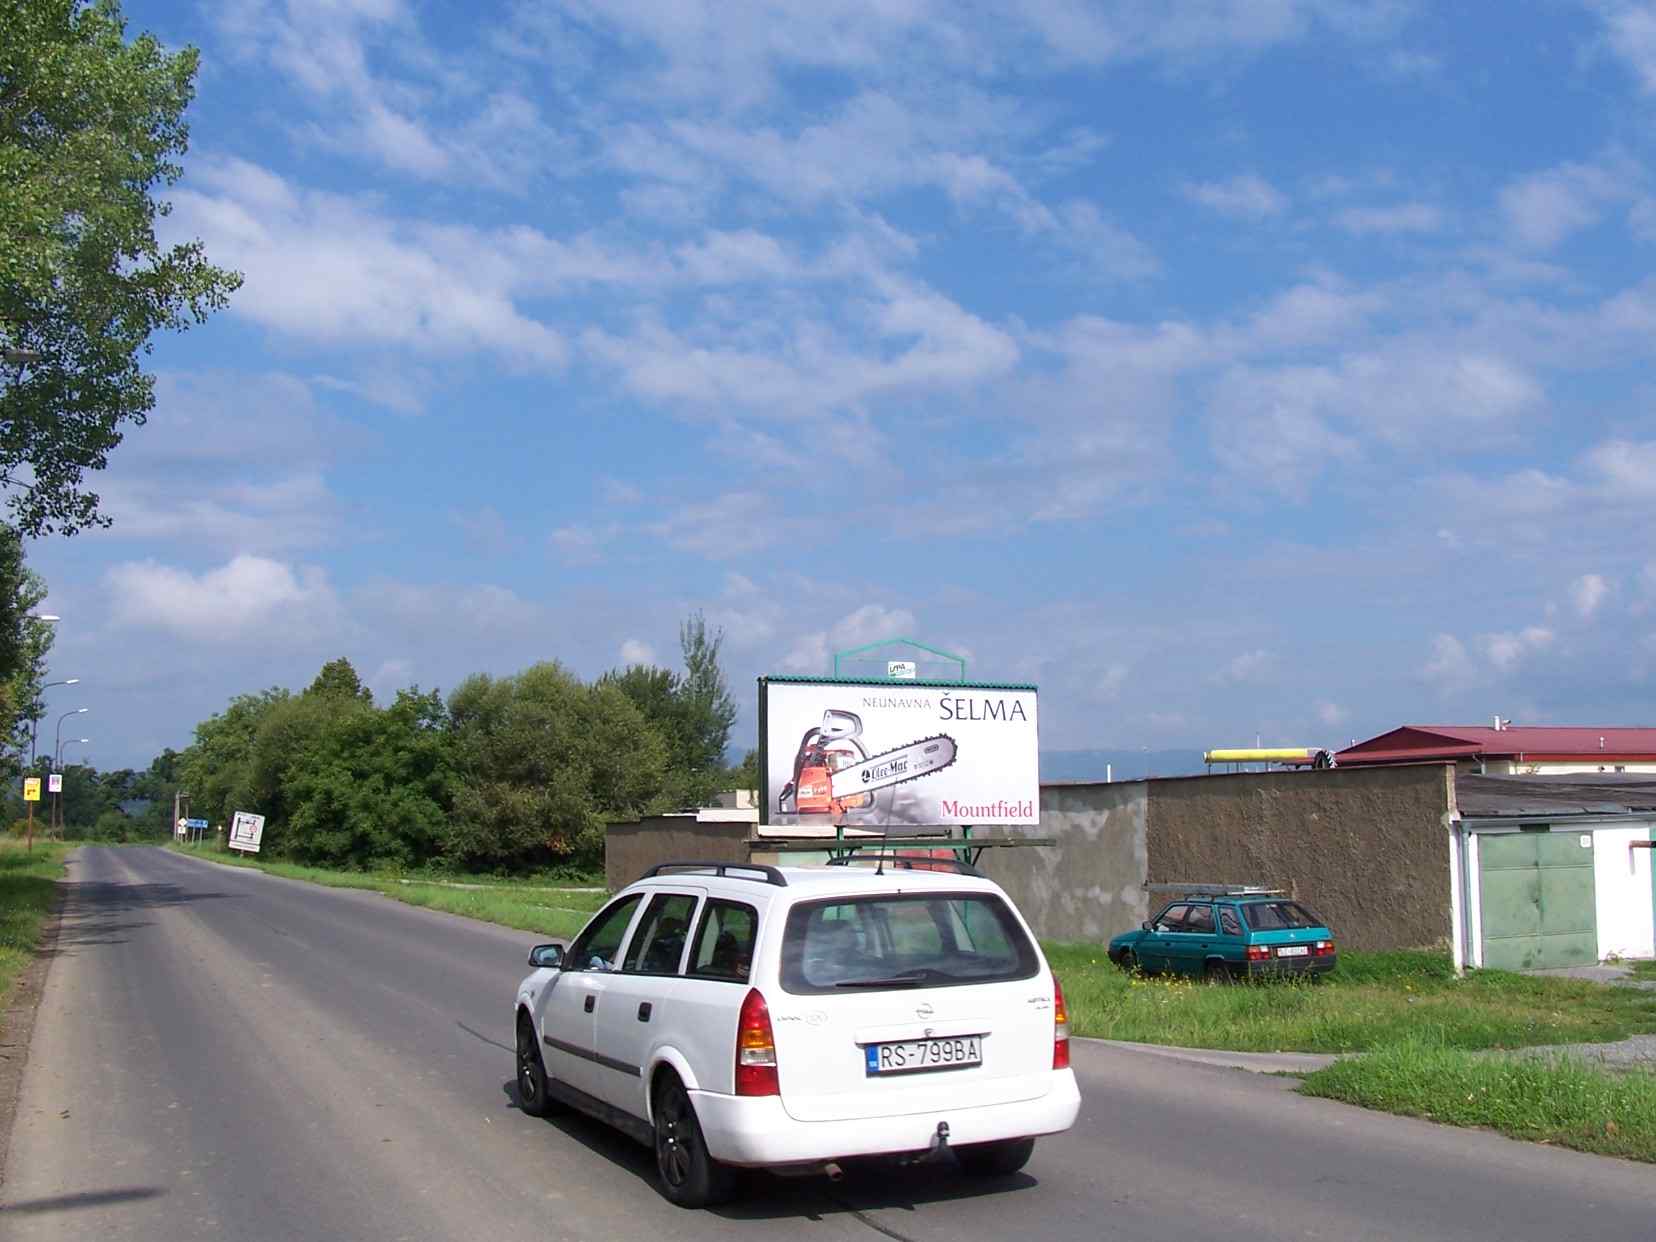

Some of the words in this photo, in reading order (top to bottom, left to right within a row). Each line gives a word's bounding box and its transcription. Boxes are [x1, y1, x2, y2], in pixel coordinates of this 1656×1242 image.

[863, 698, 932, 709] NEUNAVNA
[940, 692, 1027, 721] ŠELMA
[942, 801, 1033, 818] Mountfield
[881, 1040, 978, 1068] RS-799BA
